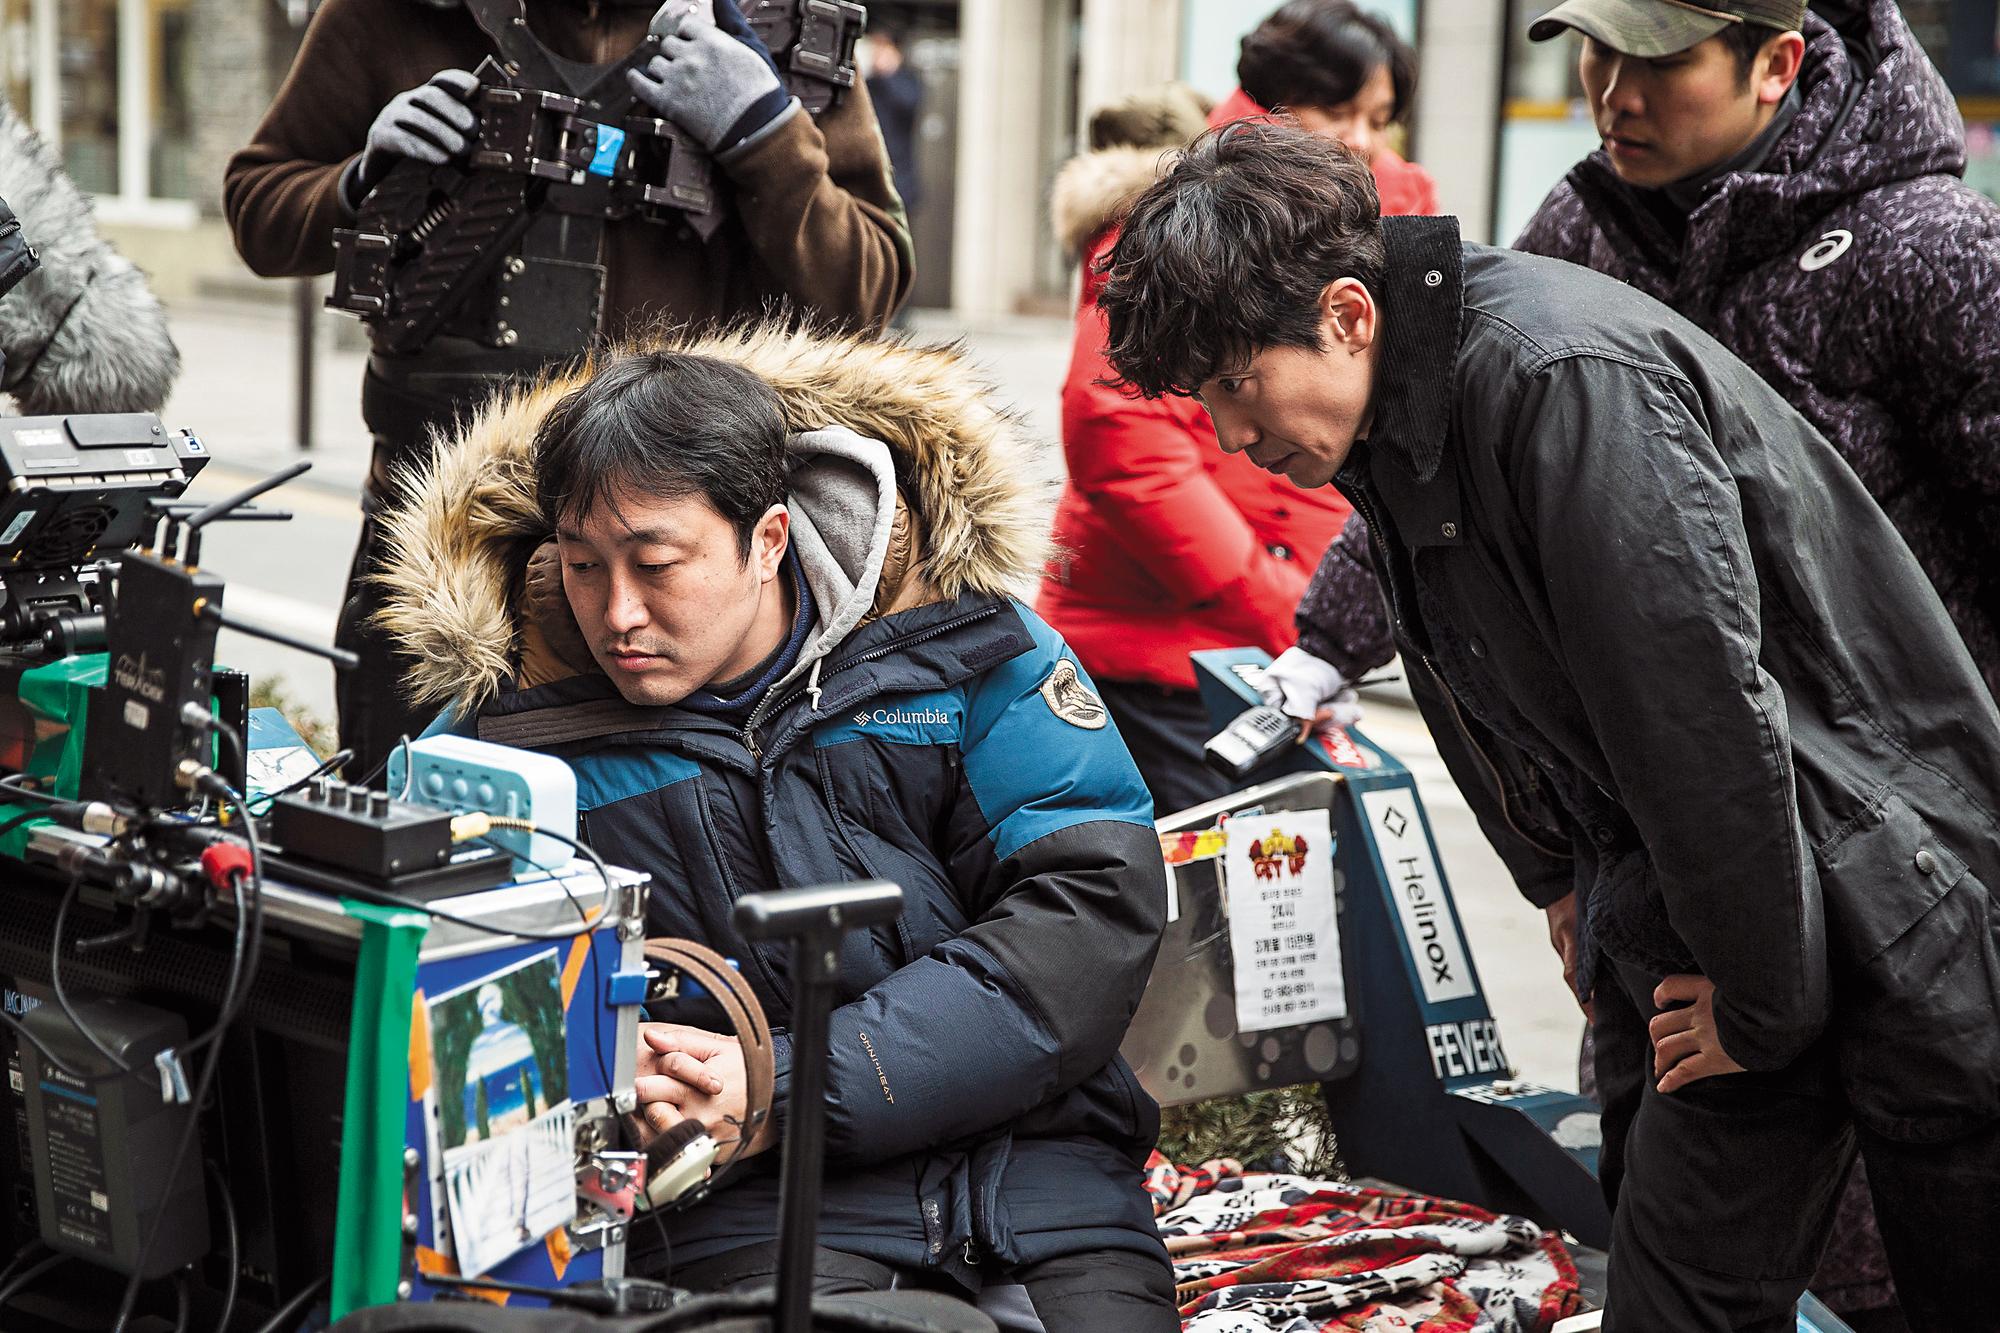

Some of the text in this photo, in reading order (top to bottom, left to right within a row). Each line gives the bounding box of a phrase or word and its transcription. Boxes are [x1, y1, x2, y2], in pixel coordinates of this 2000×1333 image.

[873, 708, 948, 725] Columbia
[1398, 856, 1454, 985] Helinox
[859, 1032, 894, 1104] OMNI-HEAT
[1426, 1018, 1506, 1080] FEVER
